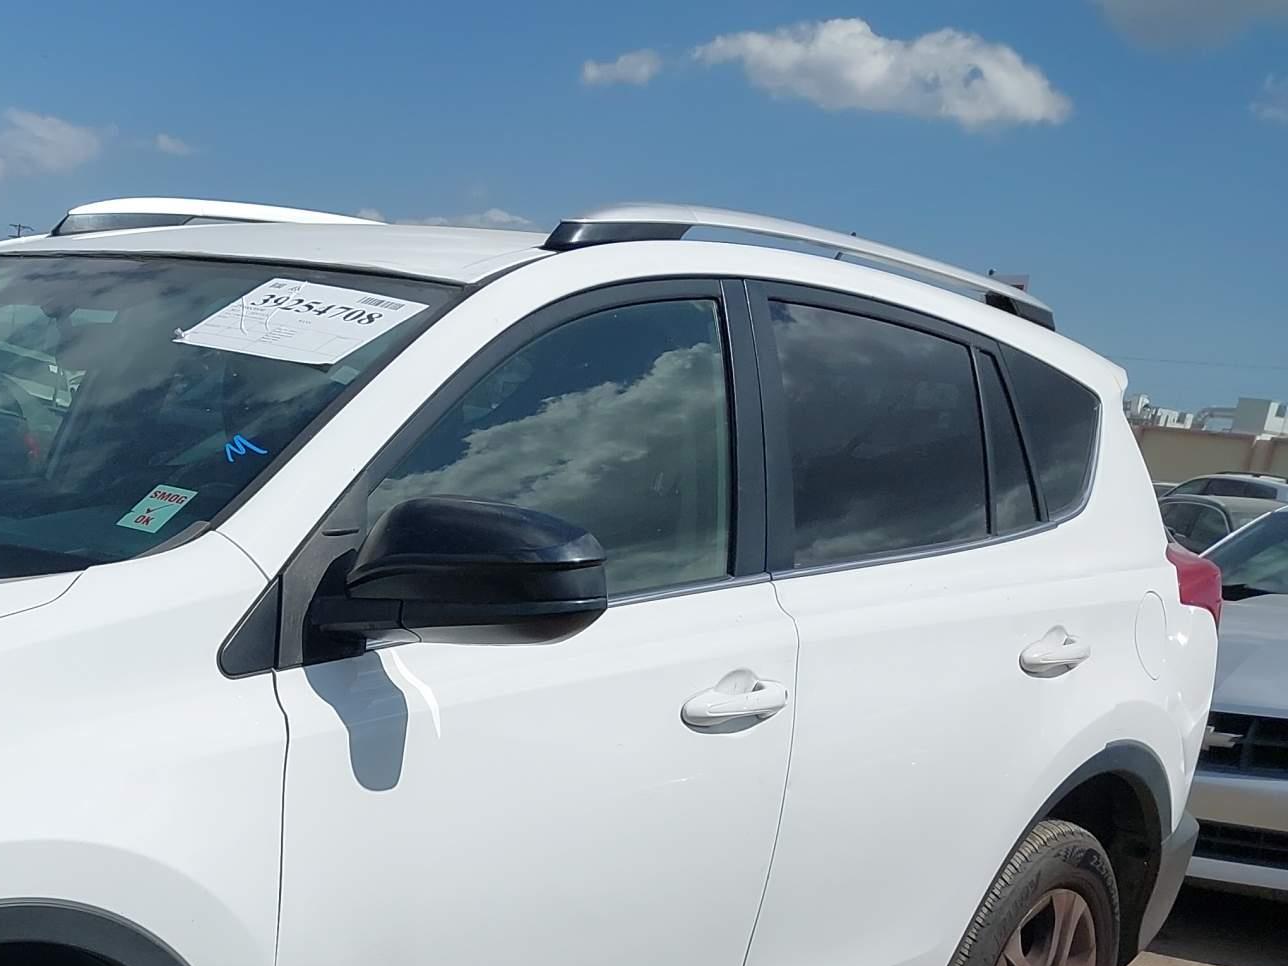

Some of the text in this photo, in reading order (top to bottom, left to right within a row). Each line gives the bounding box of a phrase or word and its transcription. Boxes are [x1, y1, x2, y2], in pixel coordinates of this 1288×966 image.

[250, 293, 384, 326] 39254708
[149, 489, 188, 506] SMOG
[133, 514, 155, 527] OK
